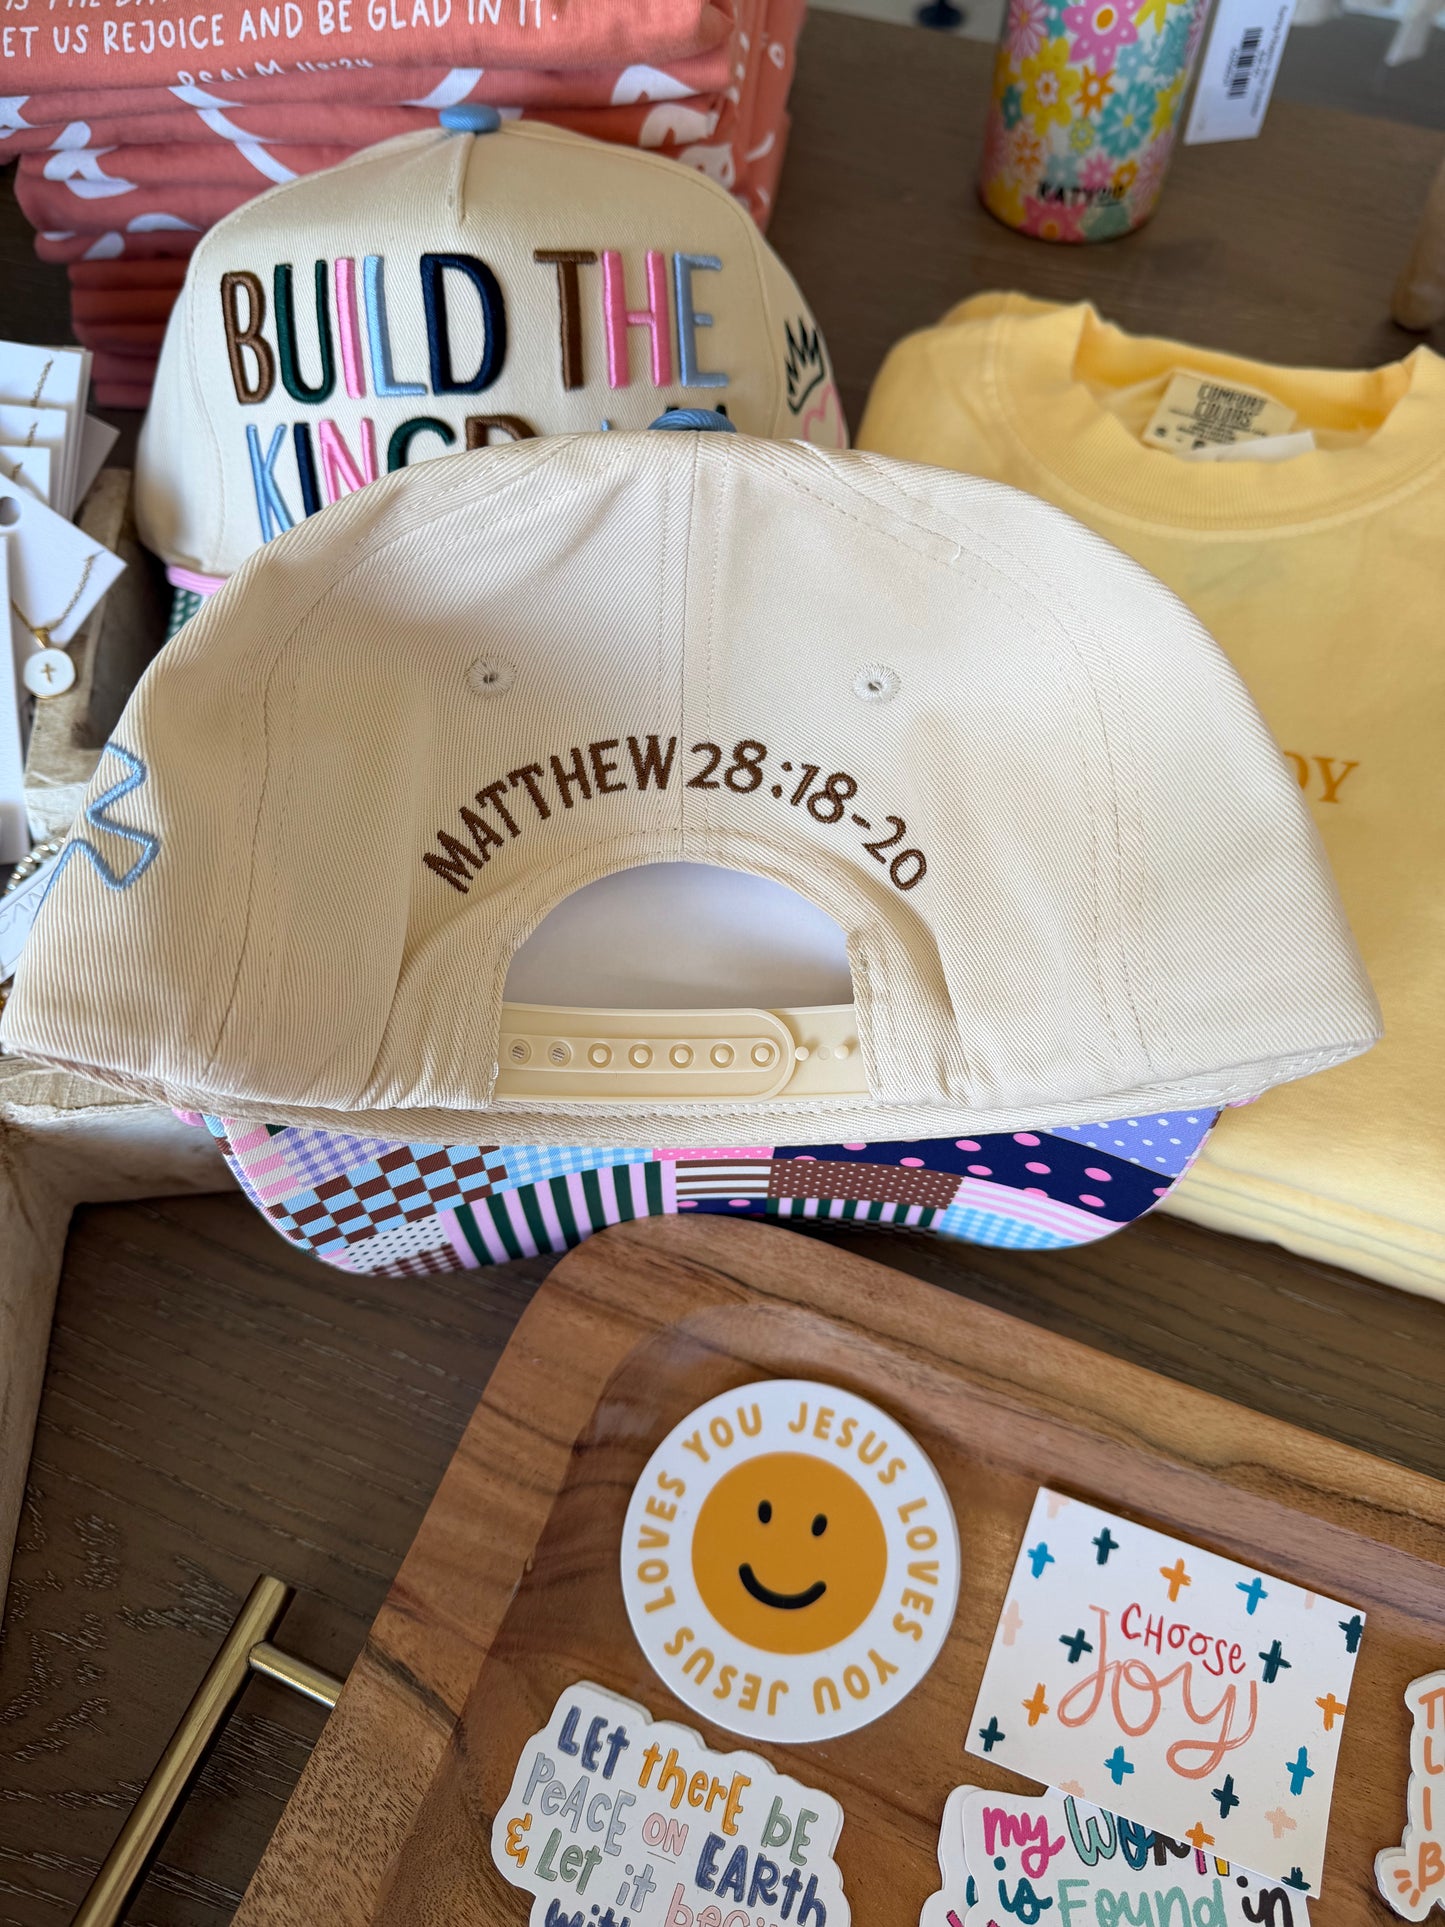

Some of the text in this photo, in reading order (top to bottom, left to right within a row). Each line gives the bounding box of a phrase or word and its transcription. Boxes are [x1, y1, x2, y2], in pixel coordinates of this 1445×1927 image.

[53, 25, 89, 54] US
[103, 14, 224, 55] REJOICE
[239, 2, 303, 42] AND
[318, 0, 352, 35] BE
[367, 0, 451, 32] GLAD
[467, 0, 500, 25] IN
[220, 249, 730, 404] BUILD THE
[422, 735, 927, 893] MATTHEW 28:18-20
[637, 1403, 789, 1716] JESUS LOVES YOU
[788, 1402, 940, 1715] JESUS LOVES YOU
[1057, 1604, 1258, 1780] Joy
[504, 1813, 533, 1868] &
[616, 1864, 657, 1912] it
[642, 1812, 690, 1857] ON
[983, 1807, 1065, 1878] my
[993, 1856, 1054, 1925] is
[1057, 1878, 1230, 1927] Found
[1236, 1875, 1294, 1927] in
